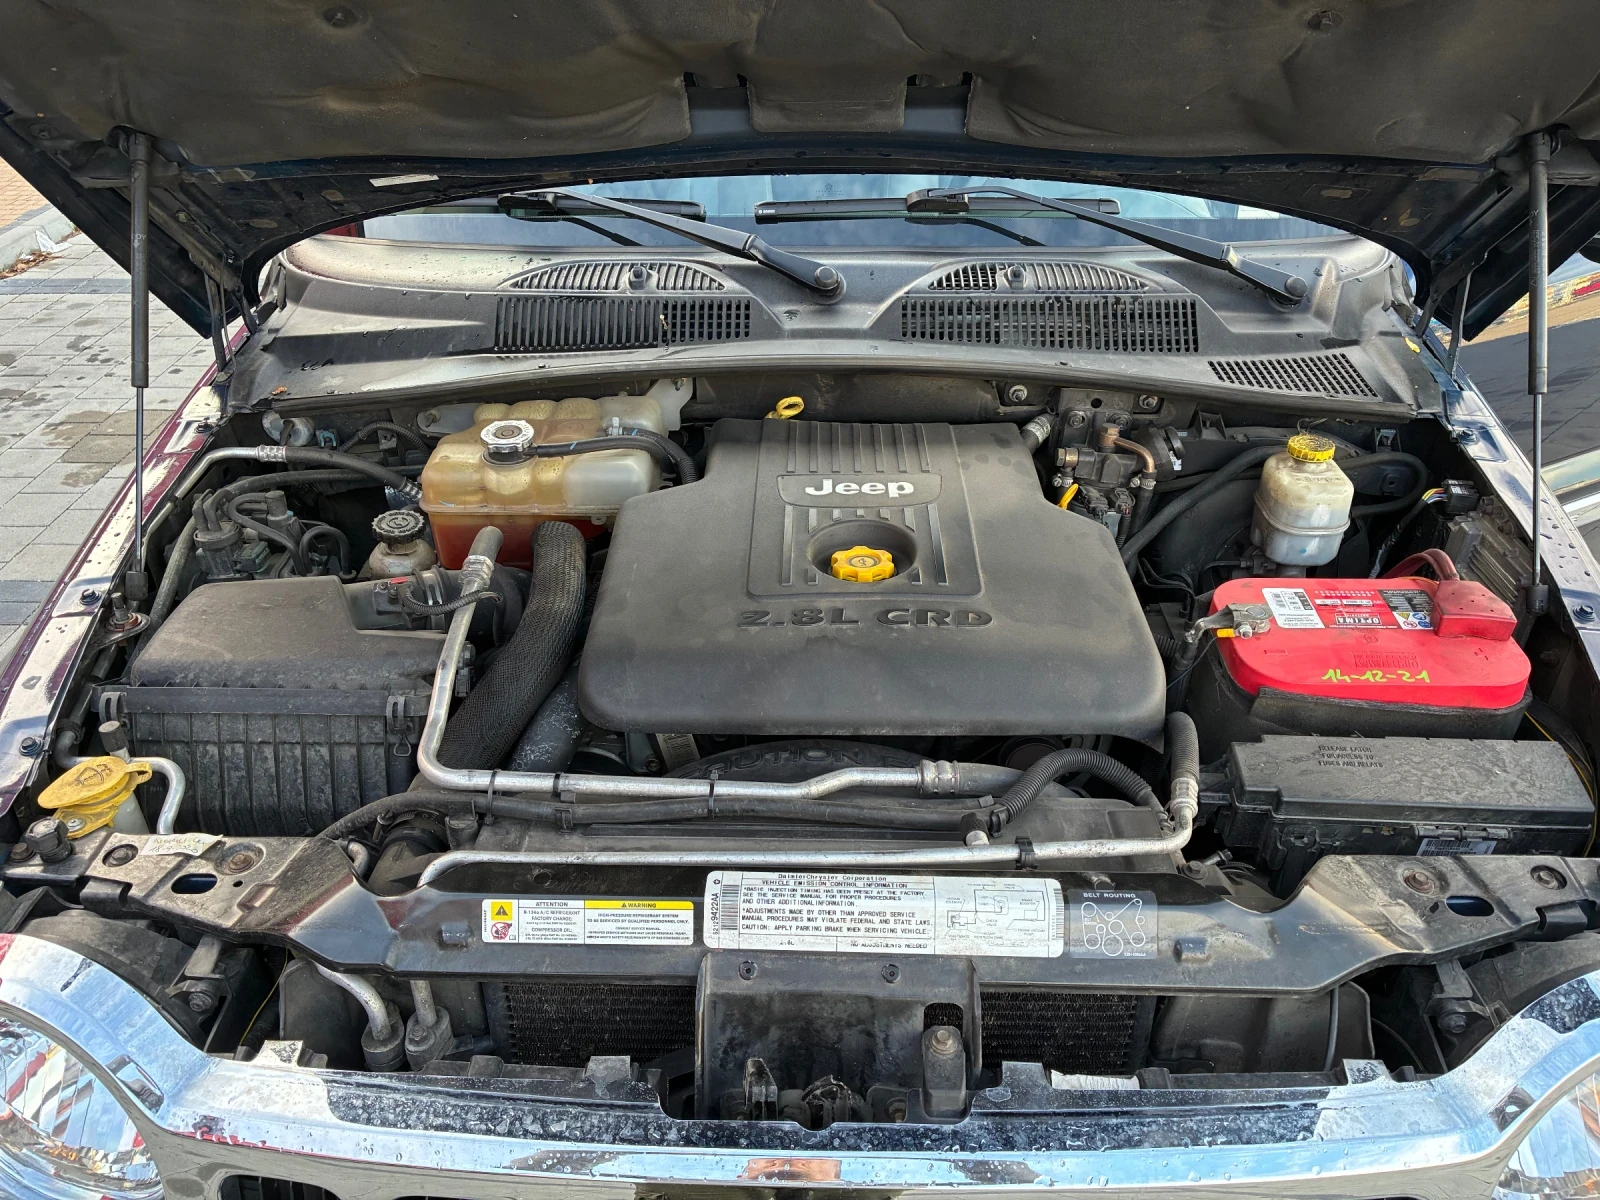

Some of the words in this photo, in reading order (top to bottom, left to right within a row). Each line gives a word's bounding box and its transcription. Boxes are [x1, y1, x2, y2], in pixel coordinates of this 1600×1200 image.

[804, 478, 914, 498] Jeep
[738, 608, 861, 628] 2.8L
[876, 608, 994, 628] CRD
[1322, 669, 1430, 683] 14-12-21
